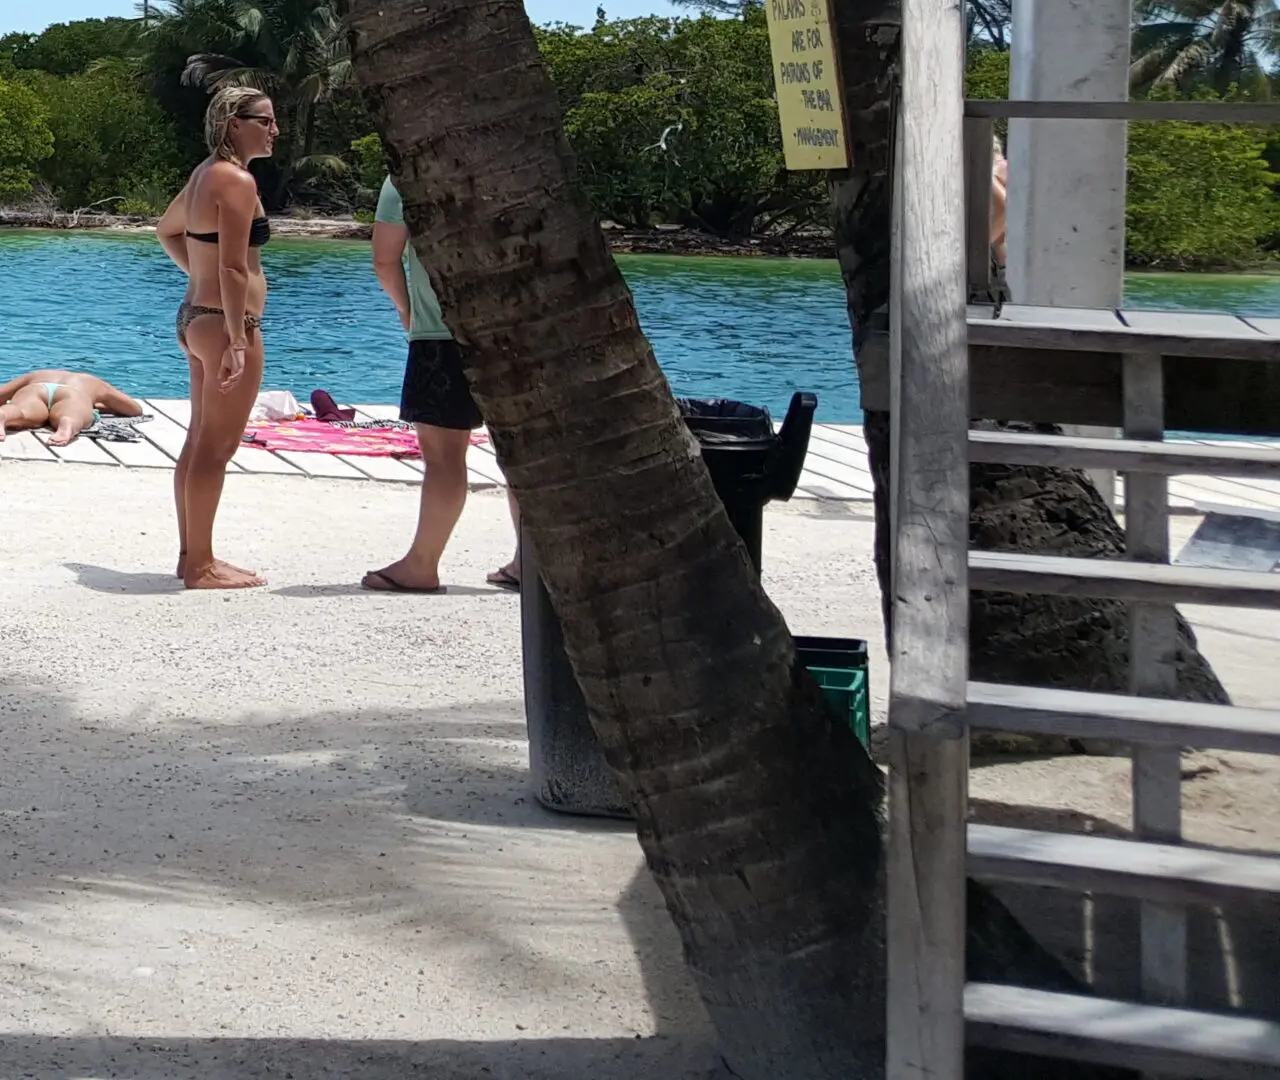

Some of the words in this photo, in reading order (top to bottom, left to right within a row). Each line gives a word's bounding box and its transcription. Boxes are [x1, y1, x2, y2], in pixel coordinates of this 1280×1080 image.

[791, 29, 806, 52] ARE
[806, 27, 823, 49] FOR
[780, 61, 811, 84] PATRONS
[812, 60, 823, 80] OF
[802, 89, 817, 109] THE
[816, 88, 834, 111] BAR
